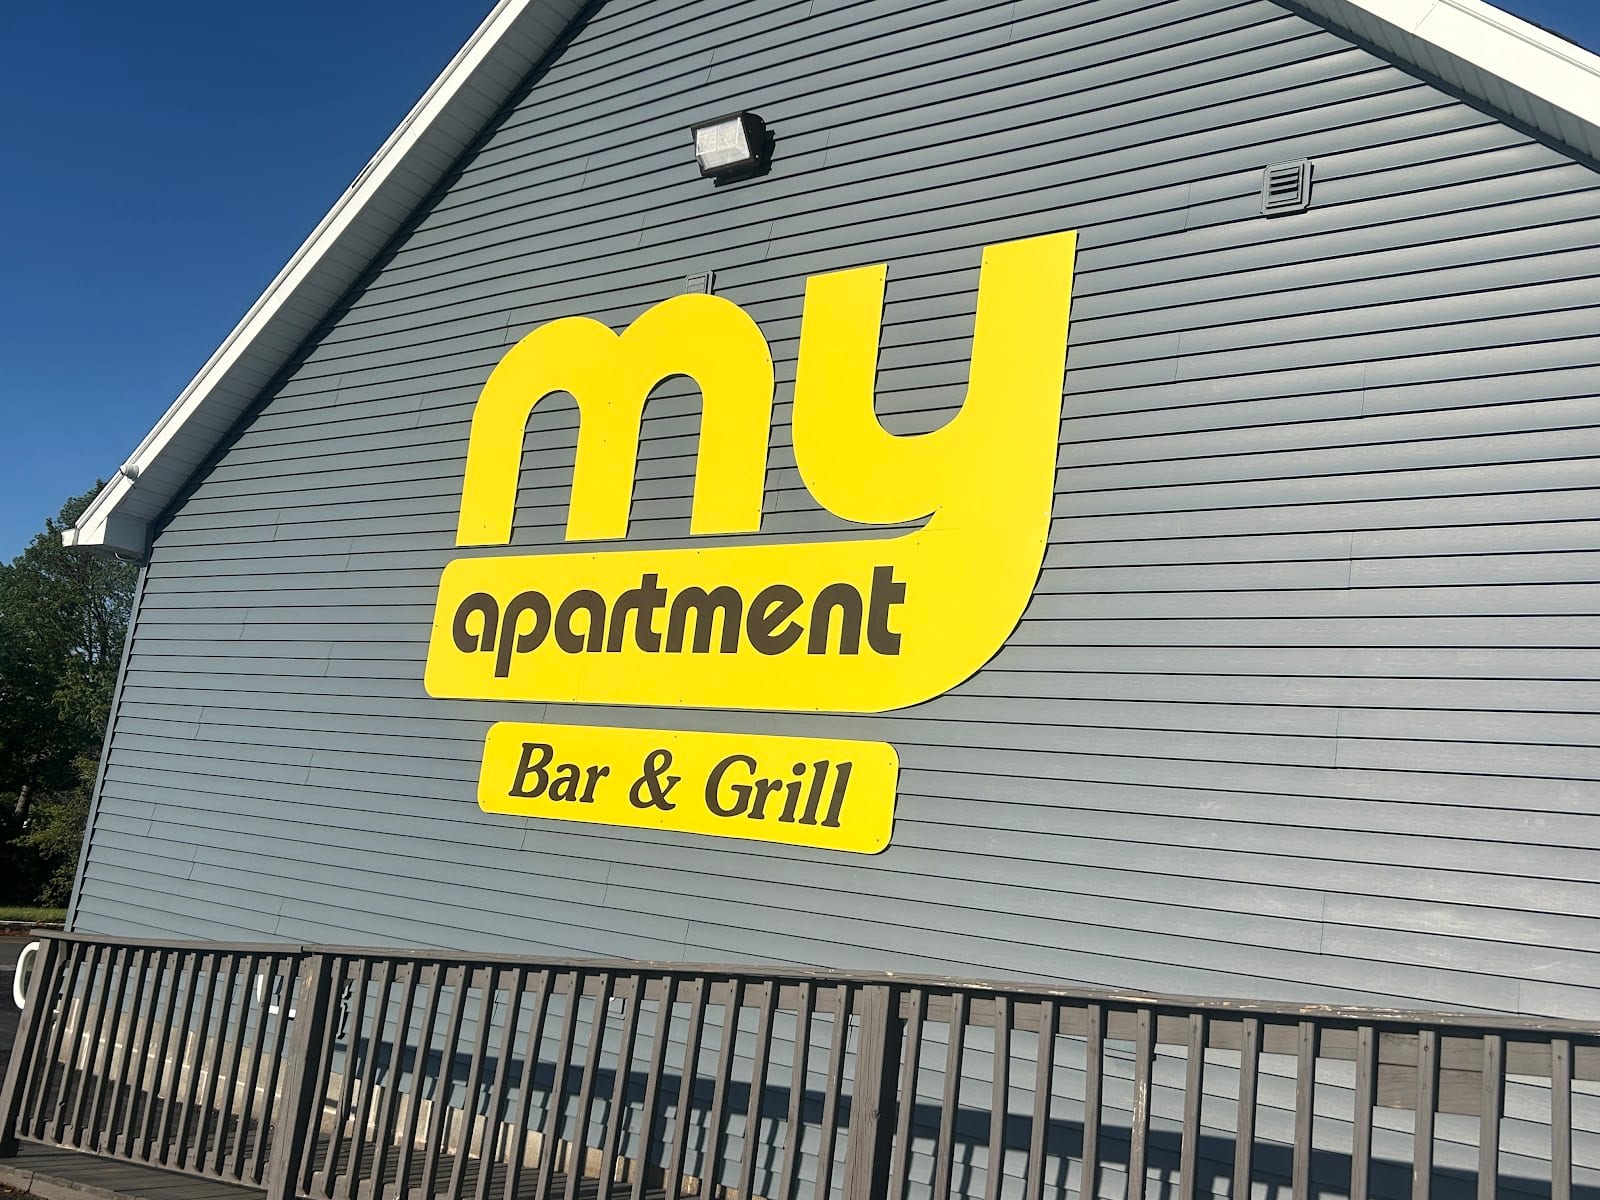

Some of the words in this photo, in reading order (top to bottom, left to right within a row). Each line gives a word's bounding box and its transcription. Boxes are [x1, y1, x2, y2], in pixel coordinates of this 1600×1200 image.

[456, 230, 1077, 590] my
[452, 565, 907, 678] apartment
[508, 742, 610, 804] Bar
[629, 749, 682, 811] &
[704, 754, 853, 828] Grill
